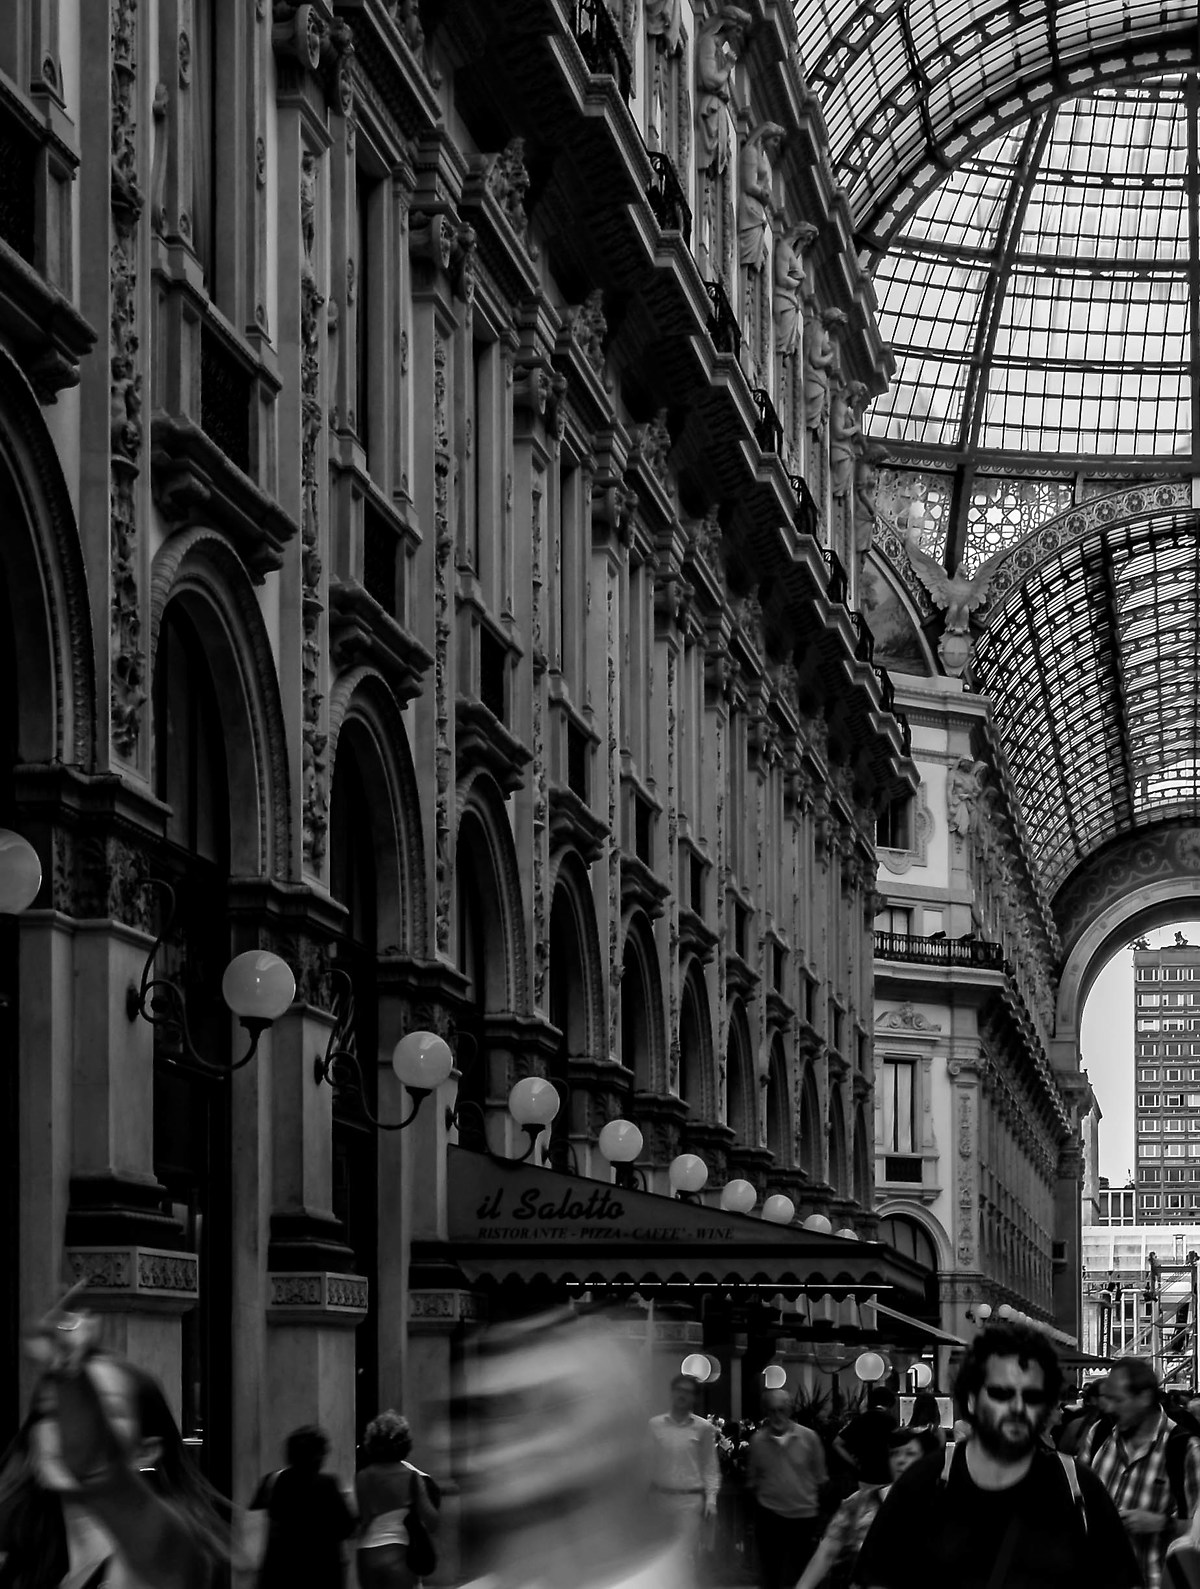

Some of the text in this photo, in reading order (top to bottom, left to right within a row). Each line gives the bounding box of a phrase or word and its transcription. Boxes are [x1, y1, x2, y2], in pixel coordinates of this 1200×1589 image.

[477, 1188, 625, 1220] il Salotto
[477, 1227, 568, 1239] RISTORANTE
[580, 1227, 621, 1239] PIZZA
[696, 1227, 735, 1239] WINE
